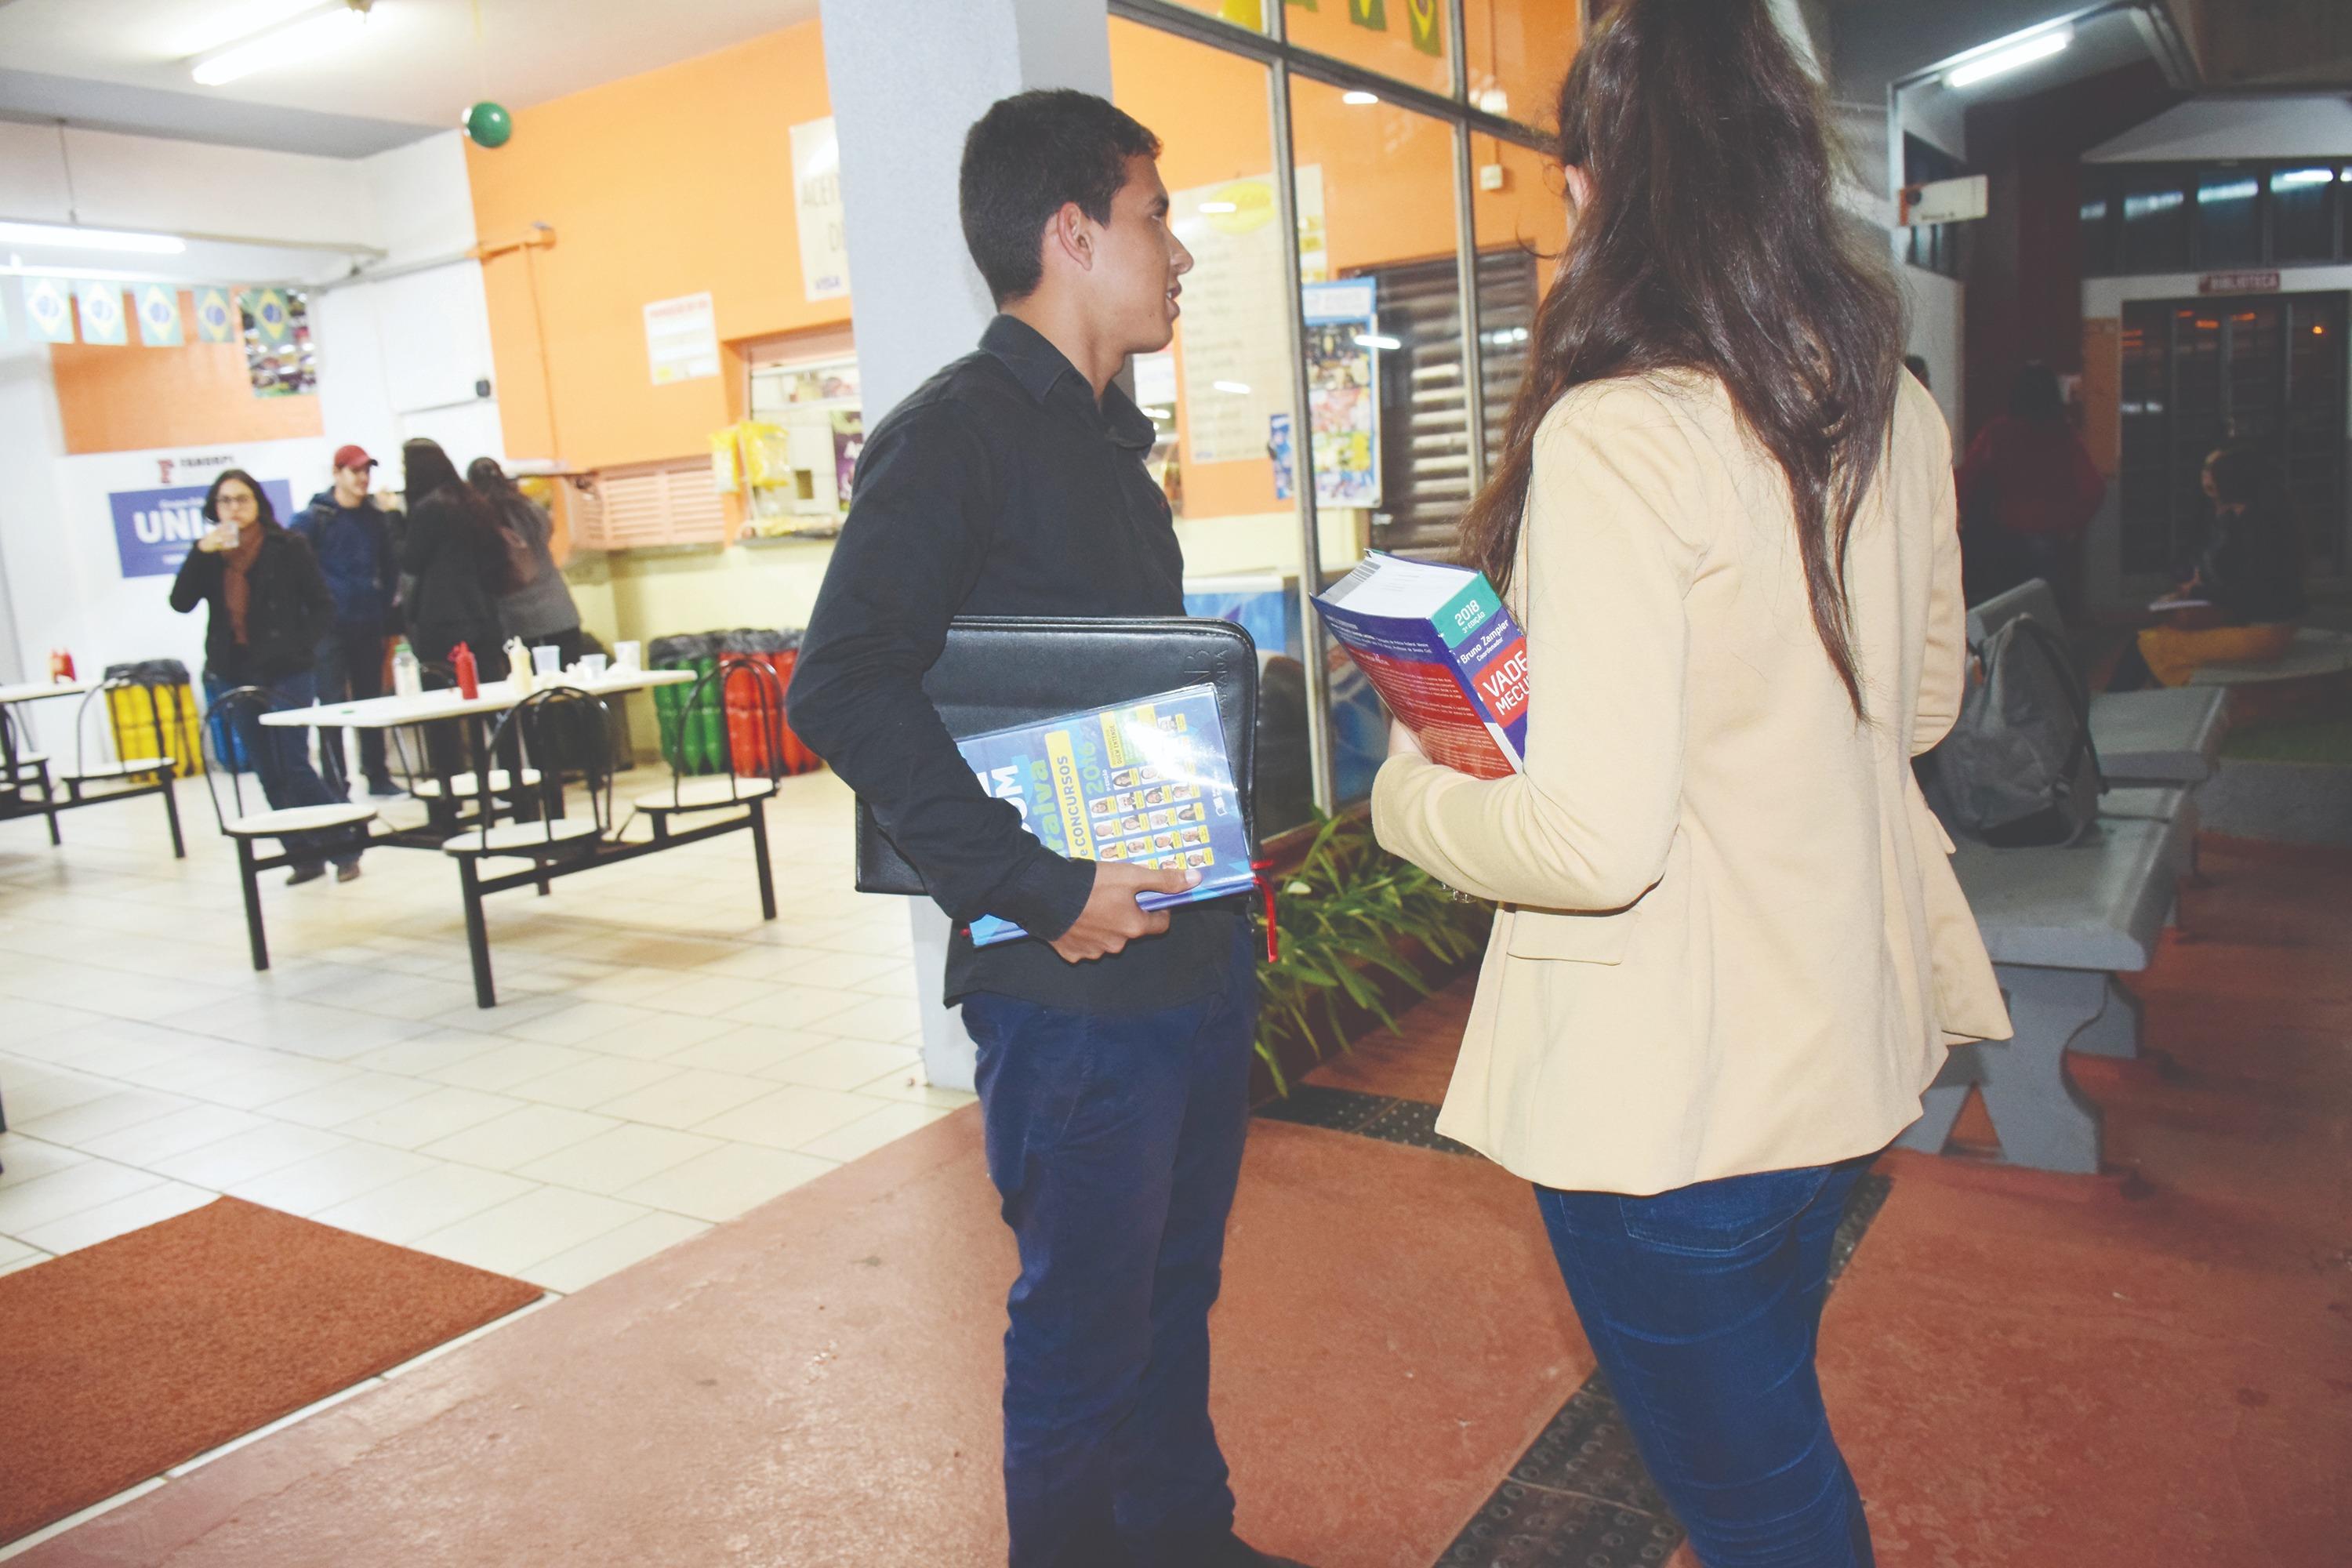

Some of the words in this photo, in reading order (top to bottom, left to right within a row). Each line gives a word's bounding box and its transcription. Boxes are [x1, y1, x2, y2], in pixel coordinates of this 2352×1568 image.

[1454, 599, 1480, 626] 2018
[1468, 611, 1486, 630] EDIÇÃO
[1460, 642, 1482, 664] Bruno
[1480, 619, 1509, 646] Zampier
[1476, 636, 1504, 662] Coordenador
[1483, 650, 1528, 698] VADE
[1079, 741, 1105, 795] 2016
[1057, 755, 1086, 847] CONCURSOS
